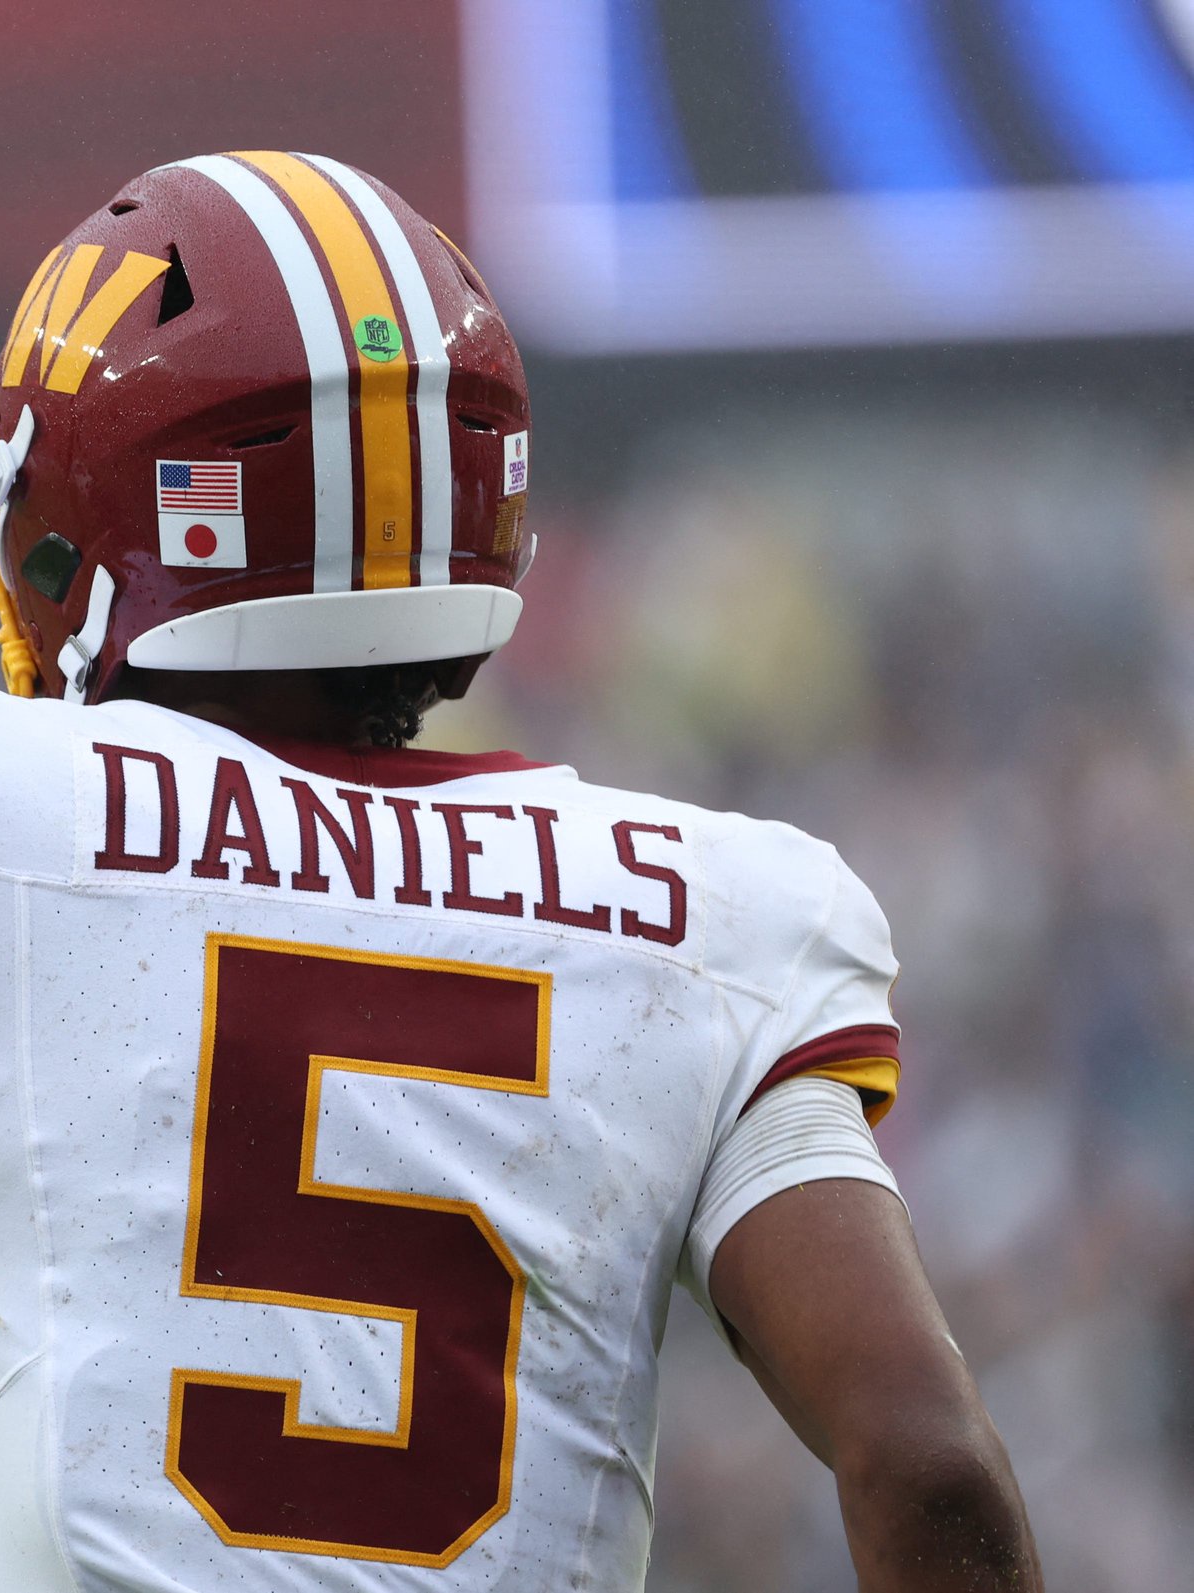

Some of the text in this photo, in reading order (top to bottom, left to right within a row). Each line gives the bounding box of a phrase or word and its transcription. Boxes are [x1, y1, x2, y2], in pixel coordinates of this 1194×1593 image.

[367, 329, 389, 342] NFL
[383, 521, 396, 541] 5
[92, 742, 688, 947] DANIELS
[164, 931, 553, 1569] 5
